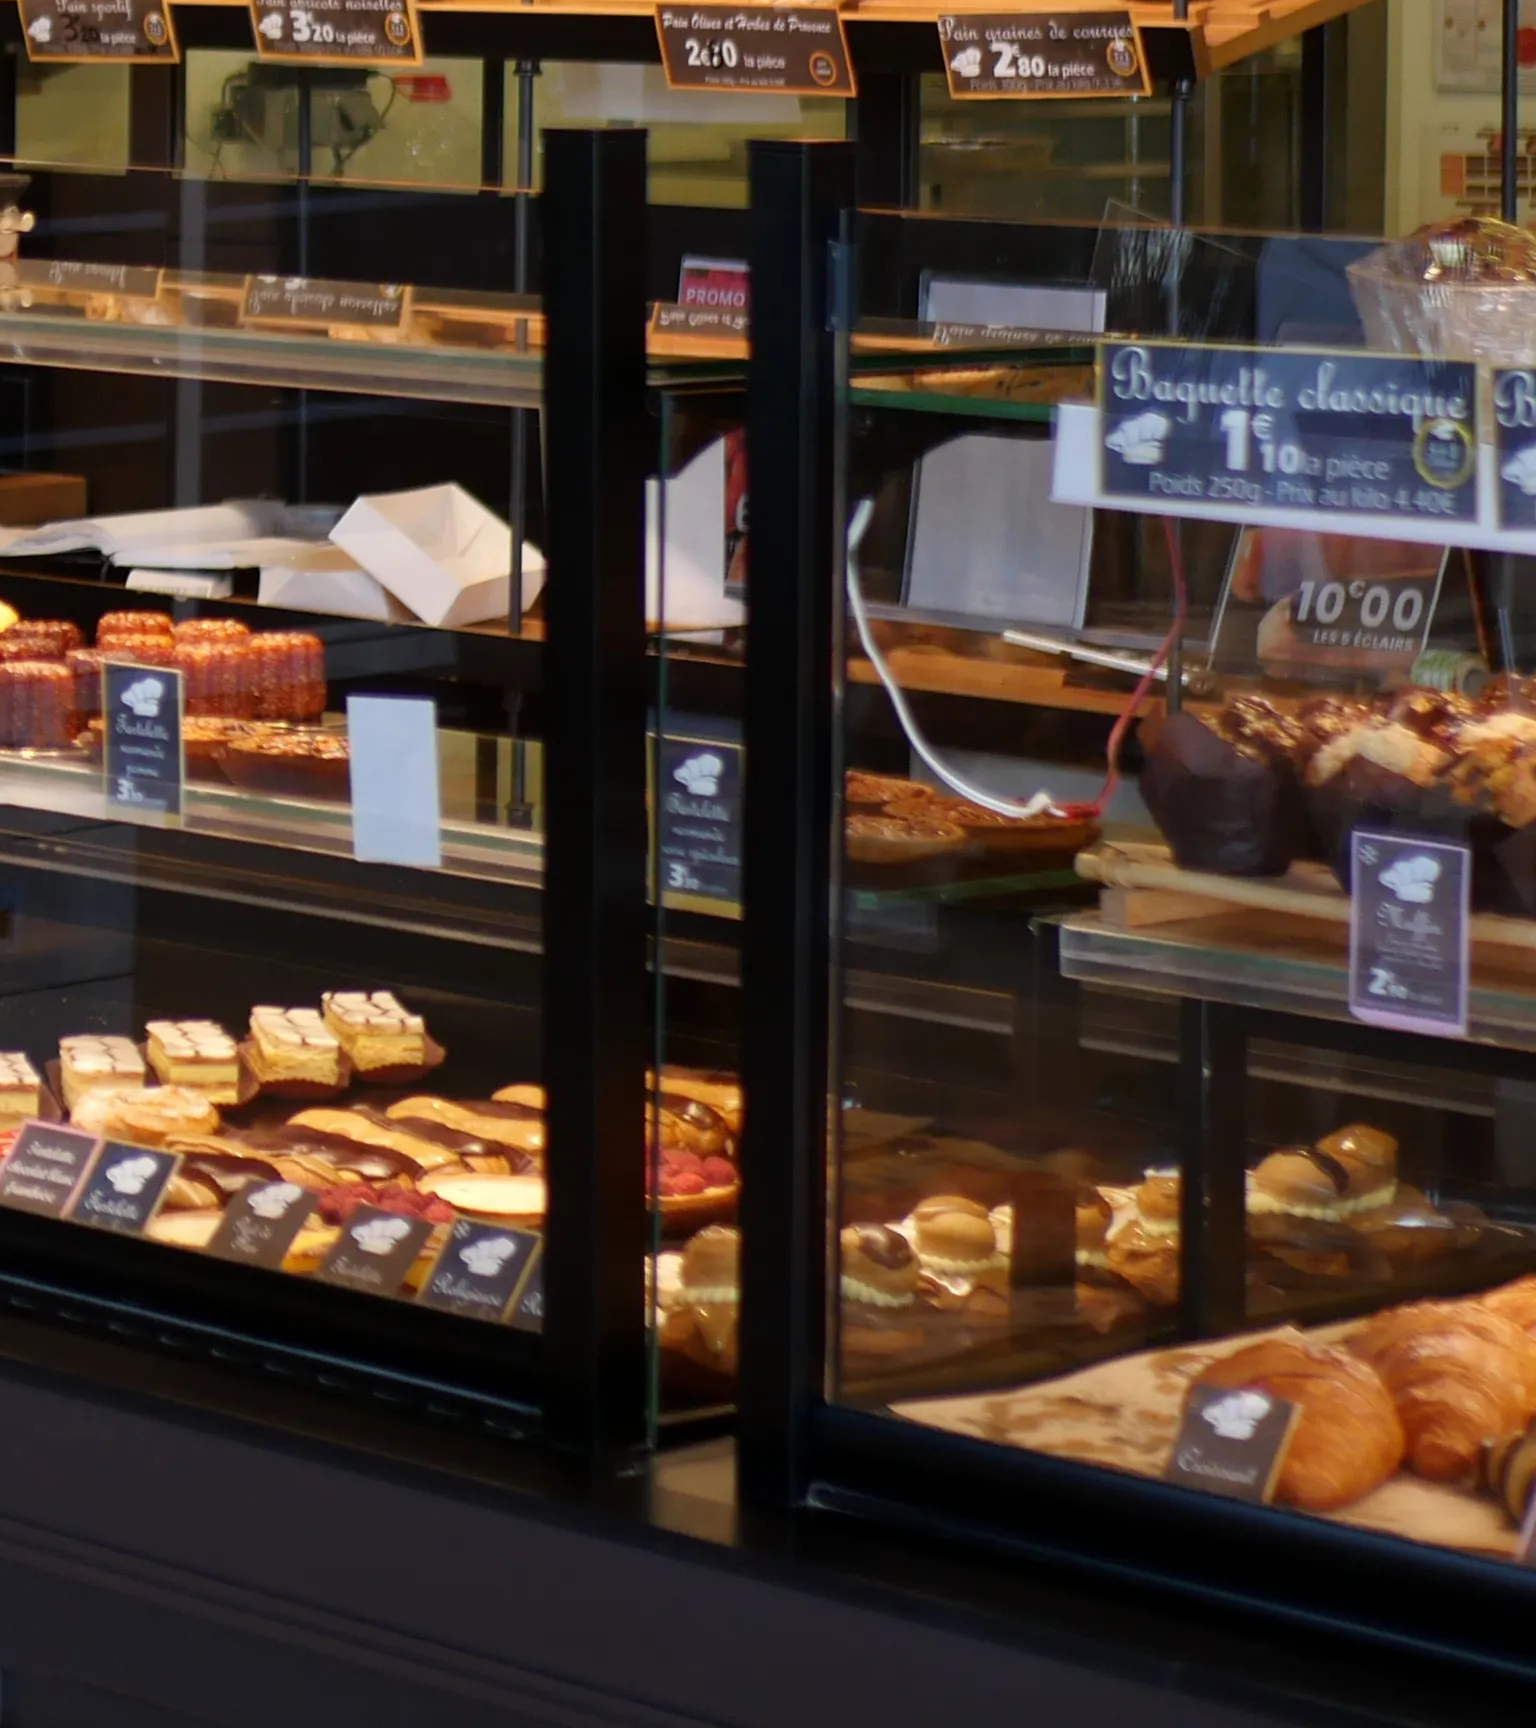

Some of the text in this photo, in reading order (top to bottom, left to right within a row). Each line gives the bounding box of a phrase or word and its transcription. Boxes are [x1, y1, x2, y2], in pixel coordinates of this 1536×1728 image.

[937, 17, 978, 41] Pain
[985, 25, 1042, 46] graines
[1049, 18, 1067, 40] de
[990, 42, 1095, 78] 2€80 la pièce
[685, 289, 746, 308] PROMO
[1112, 346, 1285, 424] Baguette
[1297, 361, 1468, 434] classique
[1220, 409, 1299, 475] 1€10
[1326, 454, 1390, 483] pièce
[1149, 472, 1203, 496] Poids
[1207, 475, 1262, 506] 250g
[1278, 480, 1315, 504] Prix
[1318, 488, 1348, 507] au
[1351, 485, 1391, 510] kilo
[1296, 579, 1424, 631] 10€00
[1313, 629, 1337, 645] LES
